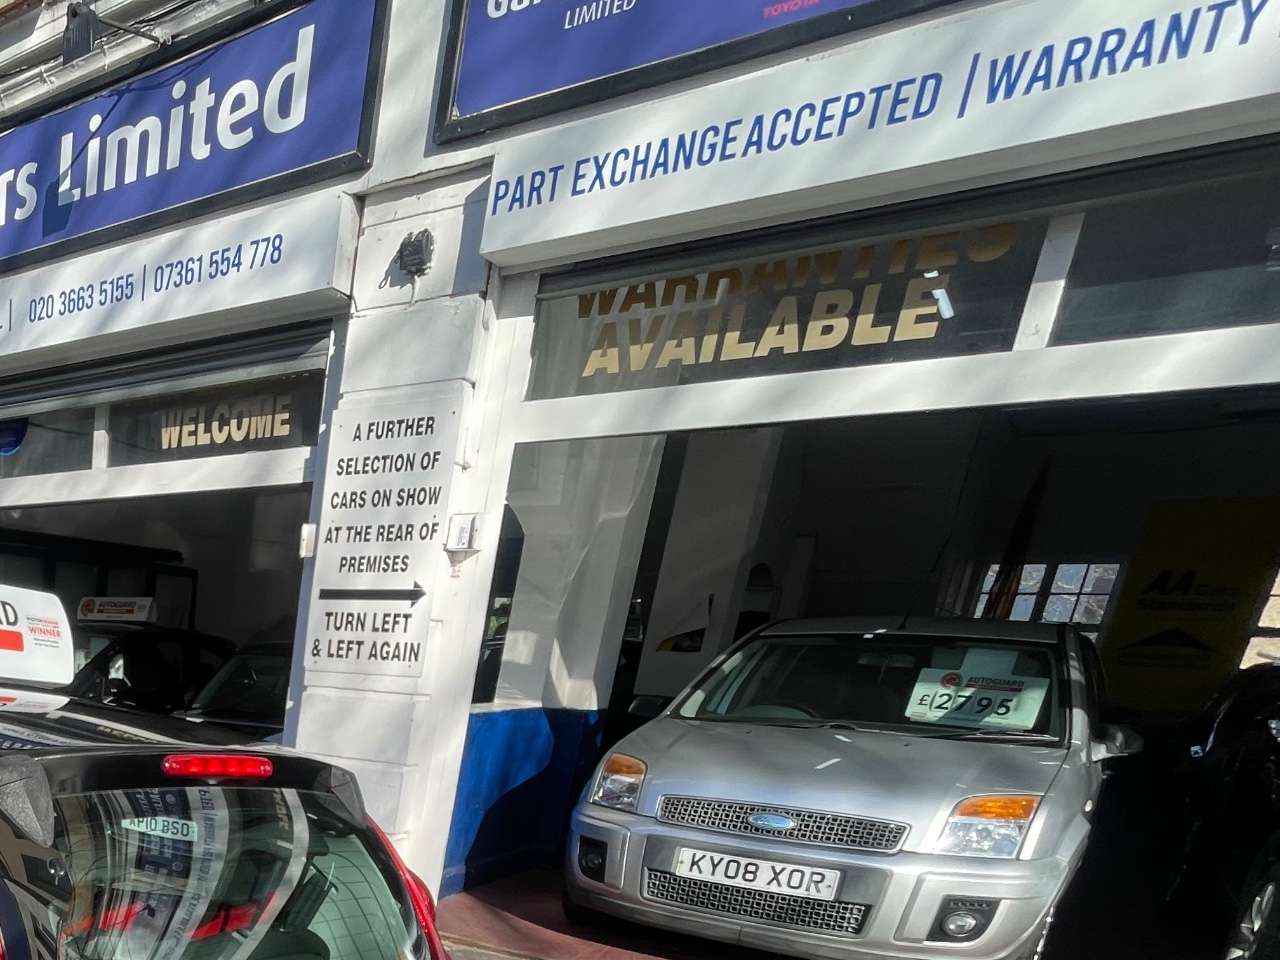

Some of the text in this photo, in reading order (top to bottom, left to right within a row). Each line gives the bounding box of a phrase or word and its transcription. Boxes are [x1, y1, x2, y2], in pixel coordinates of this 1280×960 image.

[57, 24, 316, 207] Limited
[491, 164, 564, 216] PART
[986, 0, 1269, 104] WARRANTY
[28, 295, 54, 323] 020
[58, 283, 94, 316] 3663
[98, 272, 134, 307] 5155
[154, 254, 204, 293] 07361
[208, 243, 243, 280] 554
[249, 233, 283, 270] 778
[582, 270, 950, 377] AVAILABLE
[161, 399, 291, 449] WELCOME
[352, 416, 436, 442] A FURTHER
[336, 450, 441, 476] SELECTION OF
[330, 485, 442, 510] CARS ON SHOW
[324, 522, 440, 544] AT THE REAR OF
[338, 554, 410, 573] PREMISES
[28, 625, 62, 638] WINNER
[324, 611, 412, 633] TURN LEFT
[311, 638, 421, 662] & LEFT AGAIN
[689, 852, 826, 894] KY08 XOR
